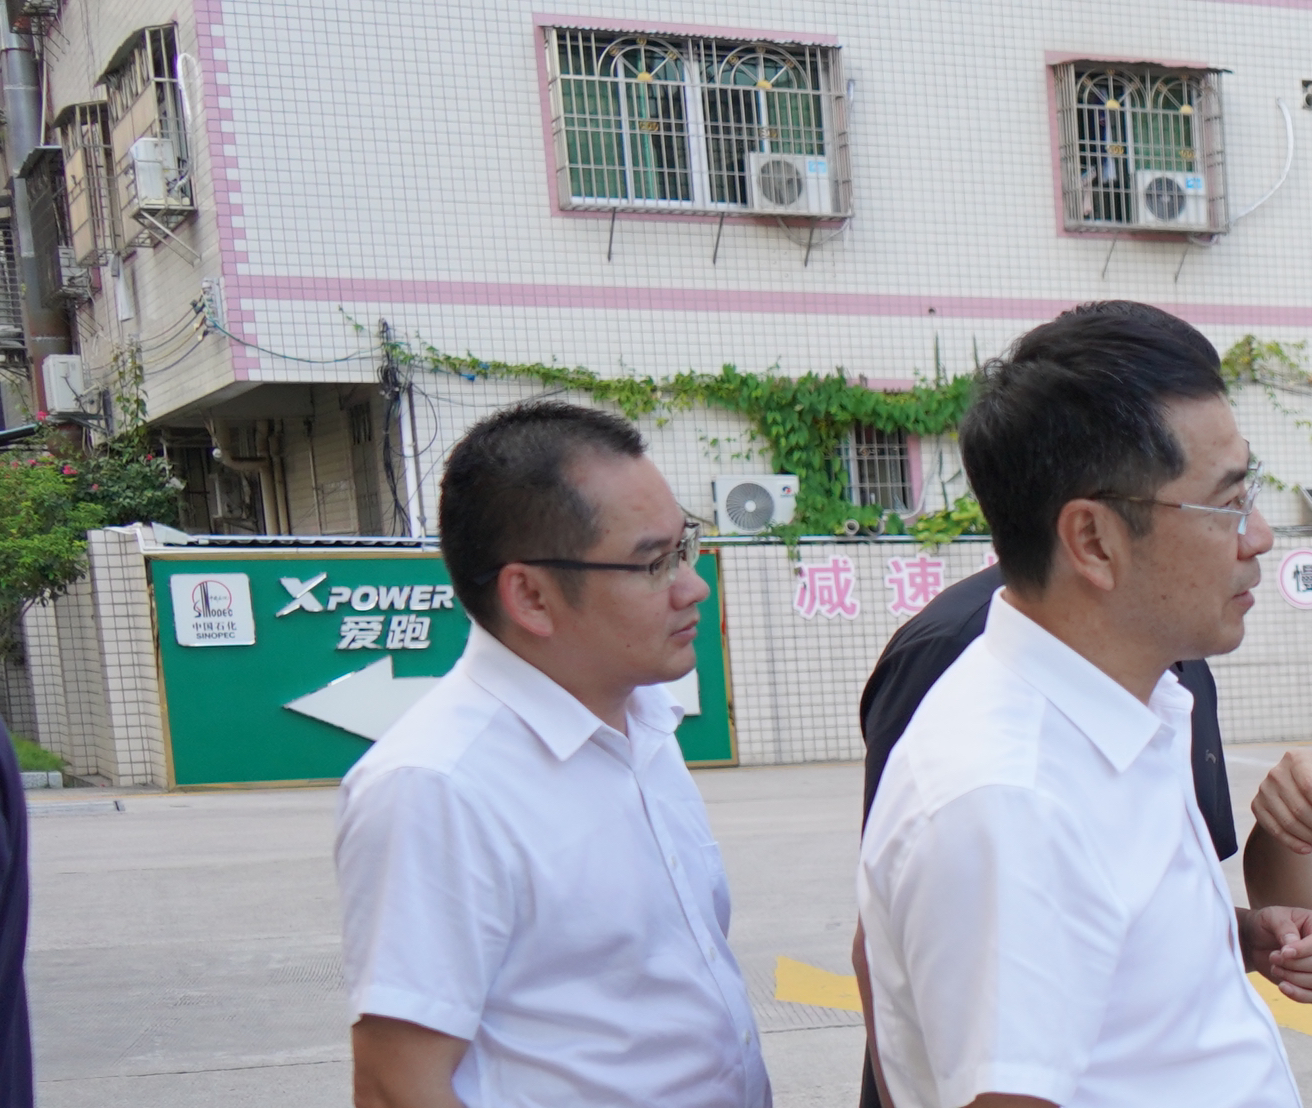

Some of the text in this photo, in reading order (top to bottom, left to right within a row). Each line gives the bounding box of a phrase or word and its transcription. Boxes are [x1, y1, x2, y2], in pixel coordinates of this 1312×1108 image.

[795, 555, 999, 617] 减速
[192, 621, 237, 632] 中国石化
[196, 631, 236, 640] SINOPEC
[335, 615, 432, 651] 爱跑
